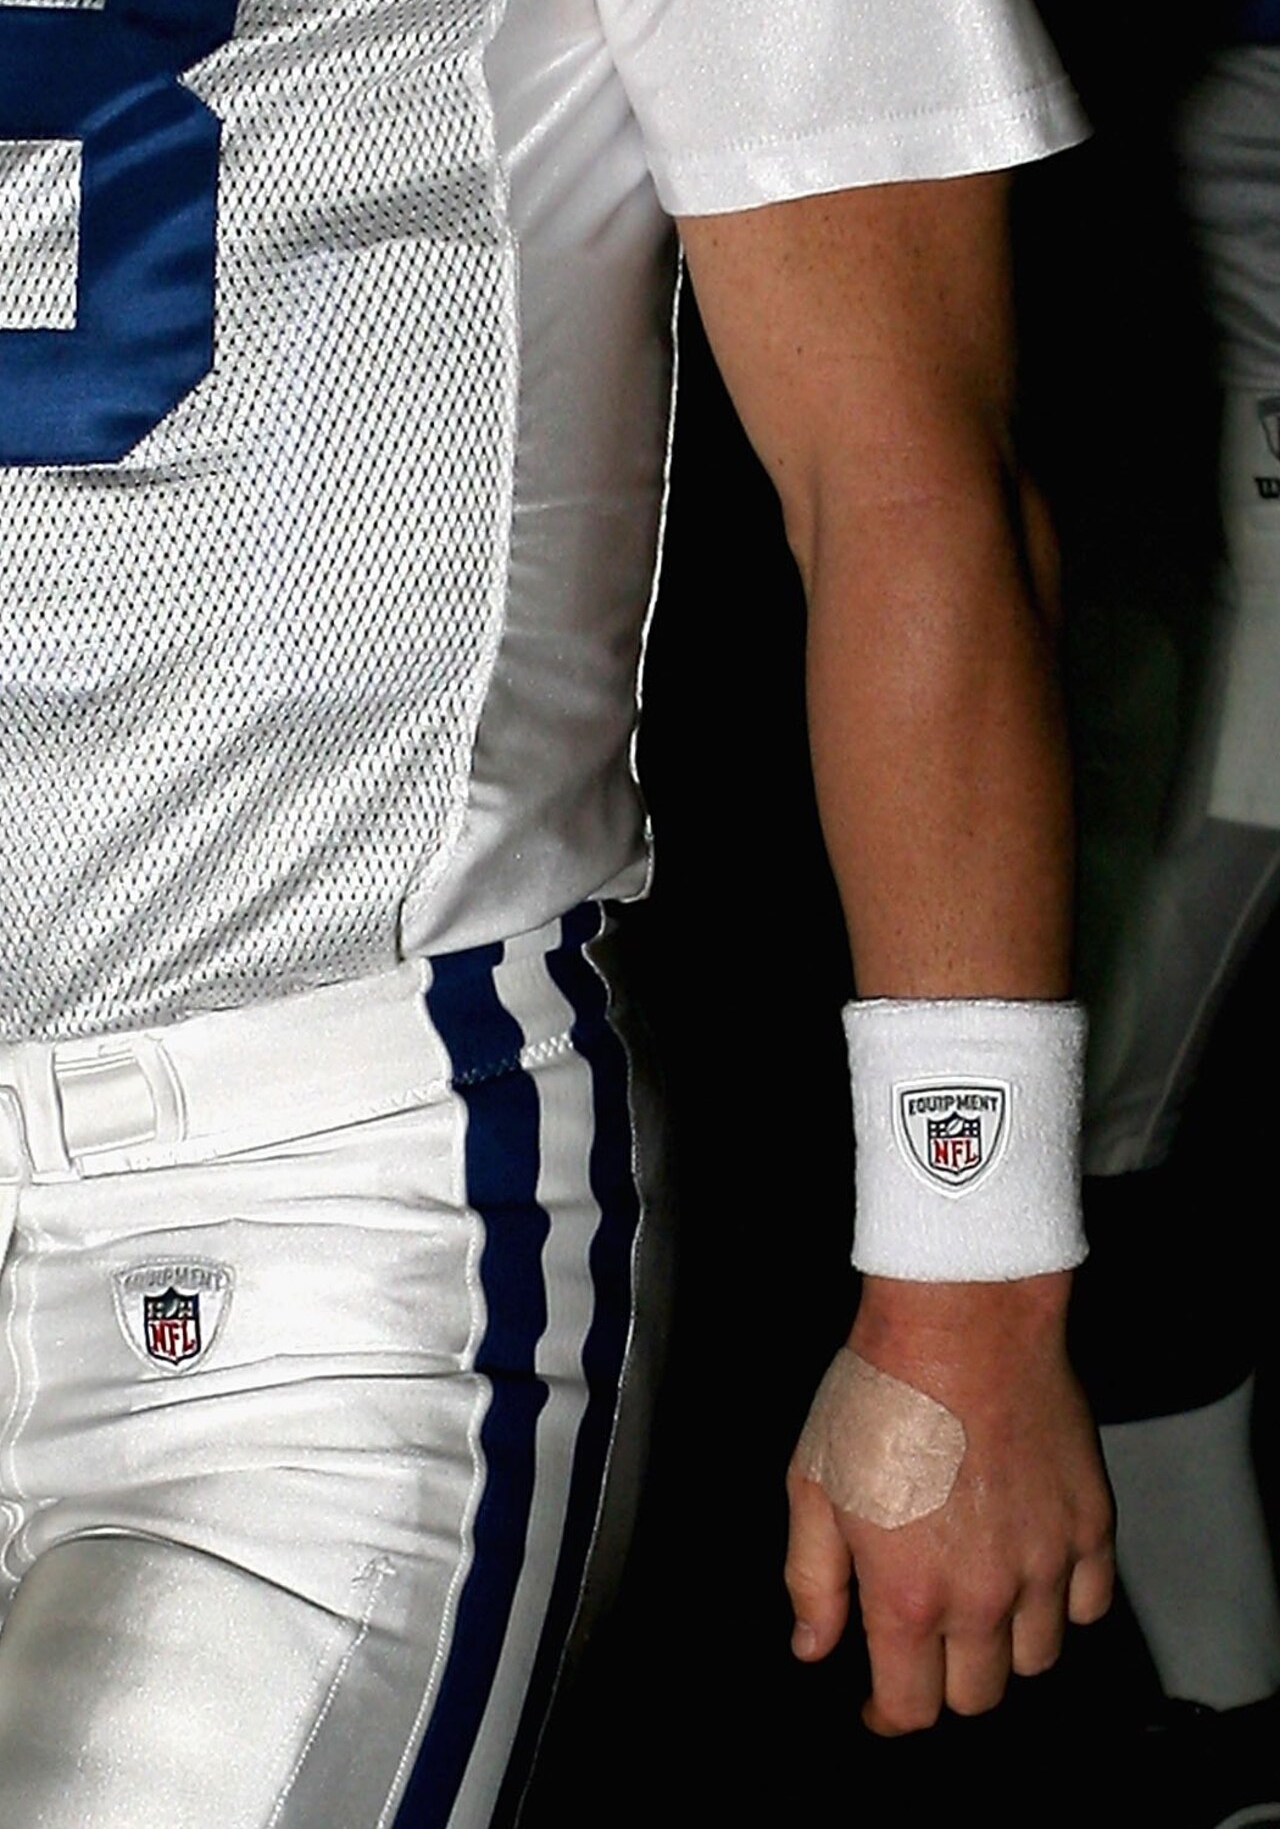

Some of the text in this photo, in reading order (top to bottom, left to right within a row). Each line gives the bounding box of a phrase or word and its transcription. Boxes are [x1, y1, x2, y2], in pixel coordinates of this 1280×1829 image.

[908, 1094, 999, 1116] EQUIPMENT
[932, 1139, 980, 1169] NFL
[149, 1319, 197, 1357] NFL
